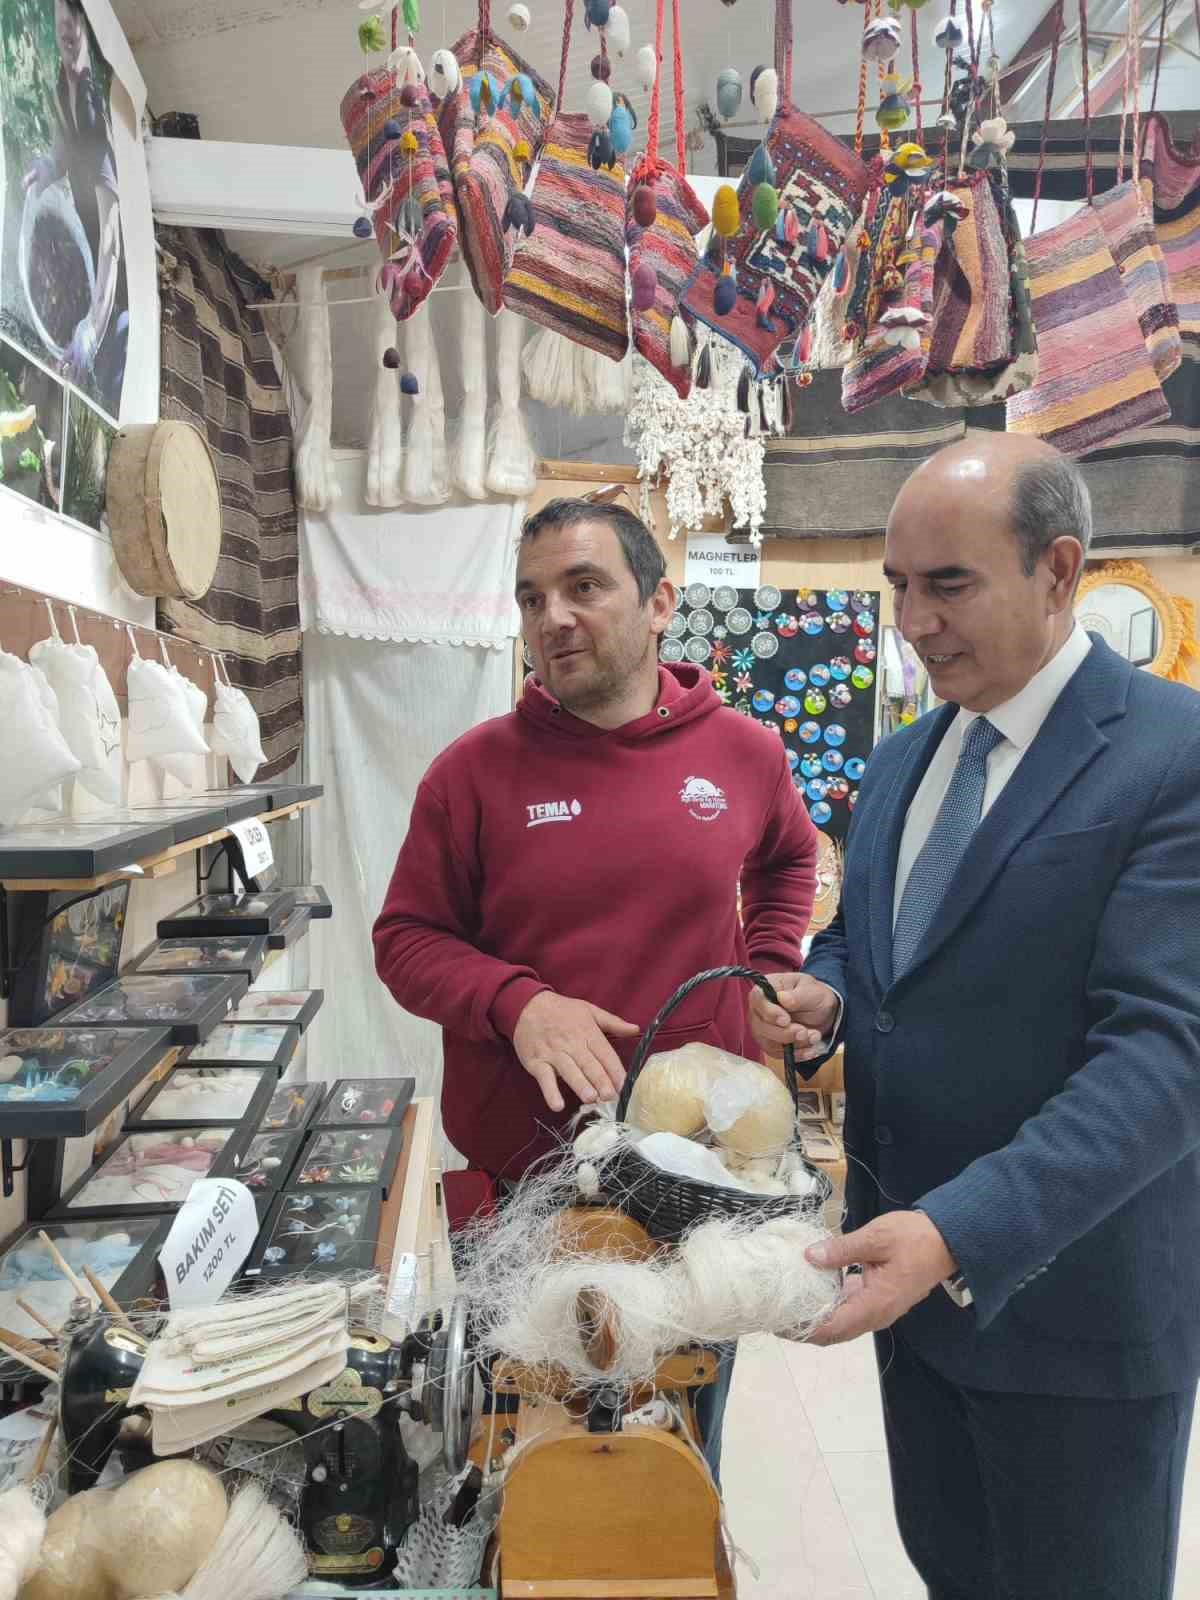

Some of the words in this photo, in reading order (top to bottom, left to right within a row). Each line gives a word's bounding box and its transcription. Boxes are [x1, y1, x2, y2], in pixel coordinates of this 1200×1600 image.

[688, 551, 758, 562] MAGNETLER
[526, 800, 570, 820] TEMA
[175, 1217, 216, 1284] BAKIM
[212, 1185, 238, 1224] SETİ
[203, 1247, 224, 1283] 1200
[224, 1232, 236, 1249] TL
